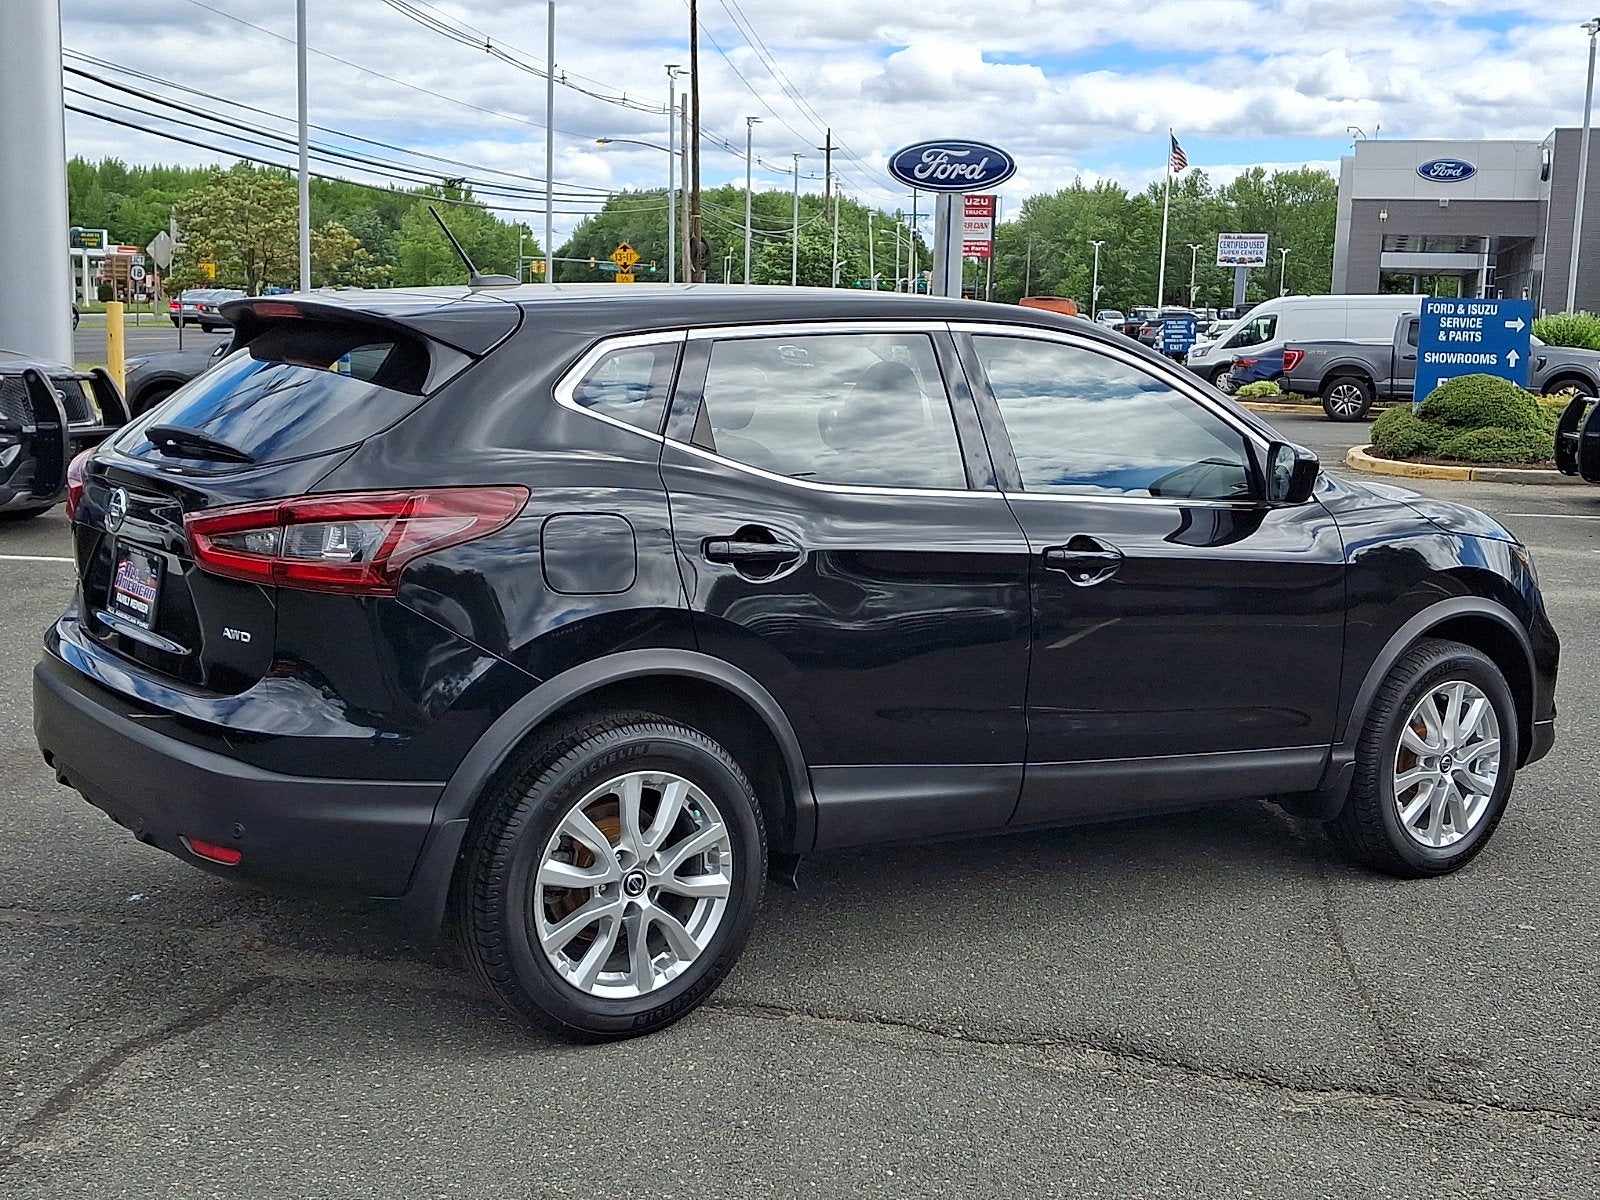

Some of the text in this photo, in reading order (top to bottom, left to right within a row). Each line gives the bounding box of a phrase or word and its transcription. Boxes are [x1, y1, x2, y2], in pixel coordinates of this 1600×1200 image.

[914, 148, 989, 180] Ford
[1430, 162, 1463, 176] Ford
[965, 198, 989, 206] UZU
[1219, 240, 1265, 250] CERTIFIED USED
[133, 269, 143, 278] 18
[1427, 303, 1498, 316] FORD & ISUZU
[1439, 317, 1483, 329] SERVICE
[1437, 330, 1482, 342] & PARTS
[1424, 352, 1498, 365] SHOWROOMS
[222, 627, 251, 643] AWD
